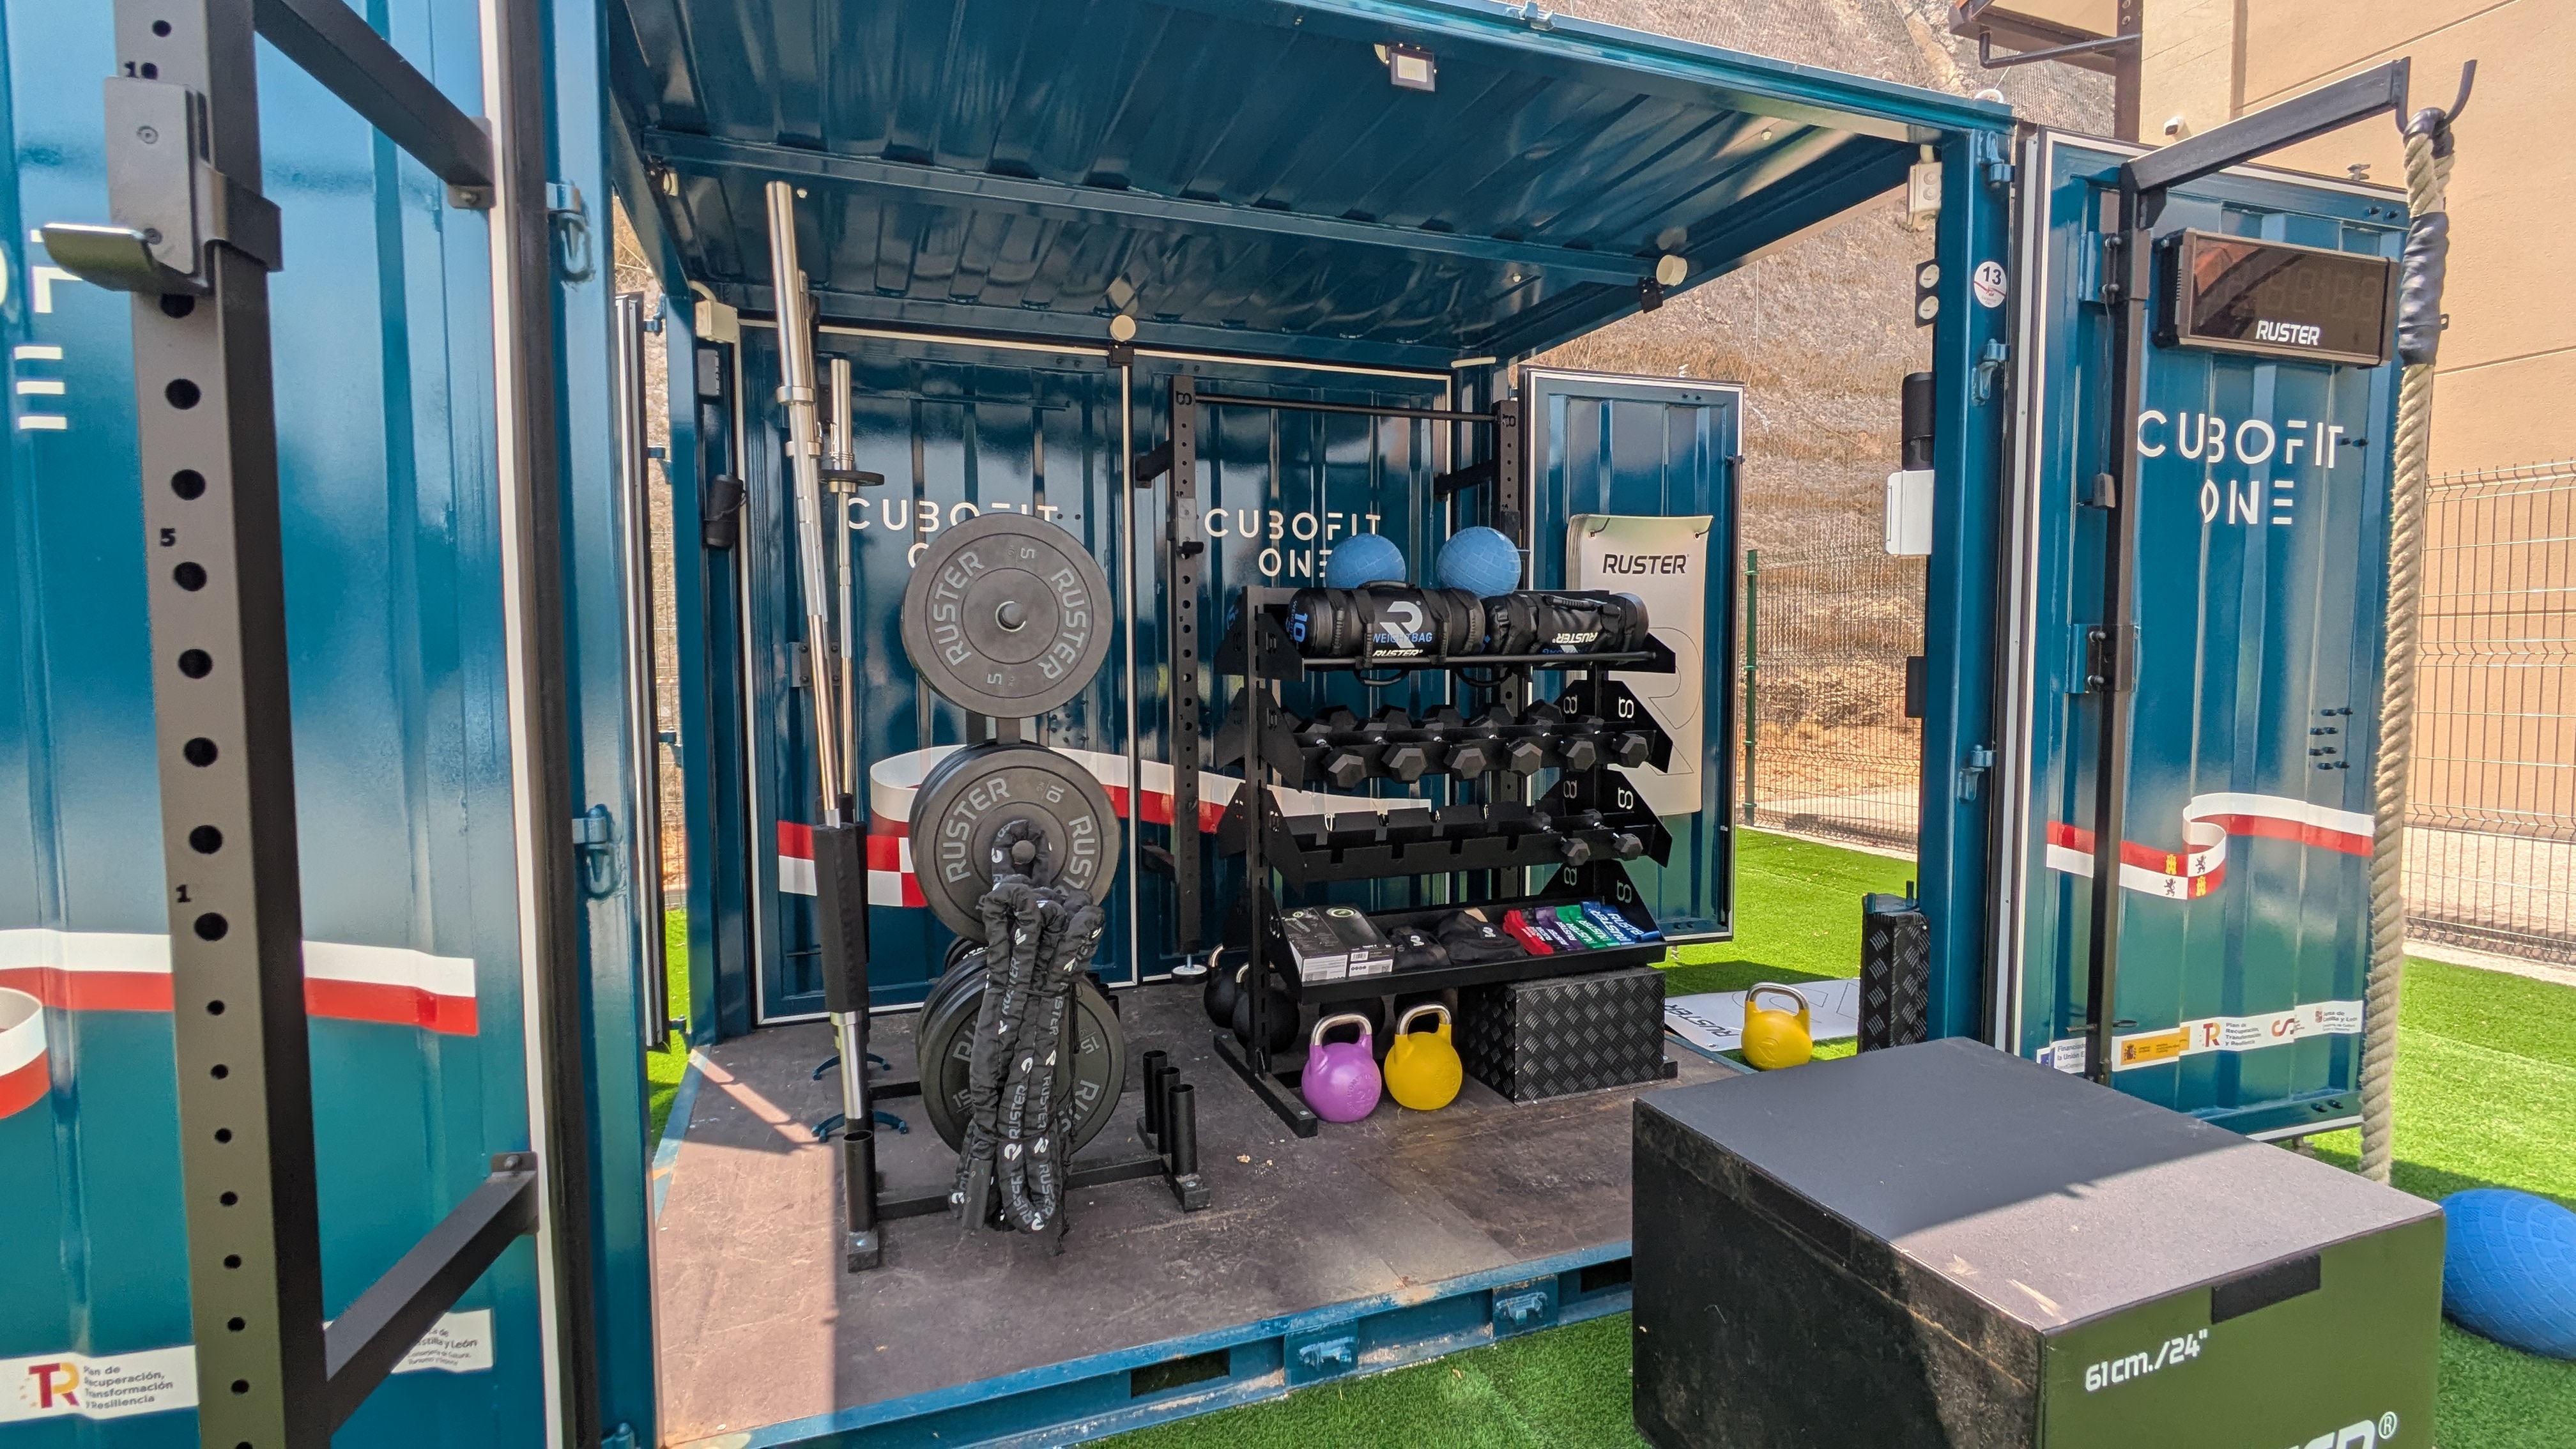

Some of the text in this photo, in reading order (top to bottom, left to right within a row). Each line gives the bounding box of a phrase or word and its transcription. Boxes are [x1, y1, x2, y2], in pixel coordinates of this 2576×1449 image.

[1982, 266, 2002, 286] 13
[2255, 319, 2320, 346] RUSTER
[2137, 410, 2344, 469] CUBOFIT
[848, 497, 1058, 532] CUBOT
[2200, 479, 2294, 525] ONE
[160, 528, 176, 547] 5
[1204, 508, 1381, 540] CUBOFIT
[1020, 547, 1035, 559] 5
[1258, 548, 1333, 578] ONE
[1602, 554, 1687, 575] RUSTER
[933, 551, 985, 666] RUSTER
[1038, 568, 1087, 680] RUSTER
[1293, 612, 1308, 643] 10
[1046, 785, 1065, 804] 10
[942, 778, 1011, 883] RUSTER
[176, 884, 192, 903] 1
[1589, 910, 1632, 942] RUSTER
[1080, 1036, 1100, 1054] 15
[1008, 1085, 1028, 1140] RUSTER
[1038, 1075, 1052, 1130] RUSTER
[451, 1338, 478, 1349] León
[105, 1366, 121, 1375] de
[85, 1381, 173, 1398] Transformación
[91, 1394, 155, 1409] Resiliencia
